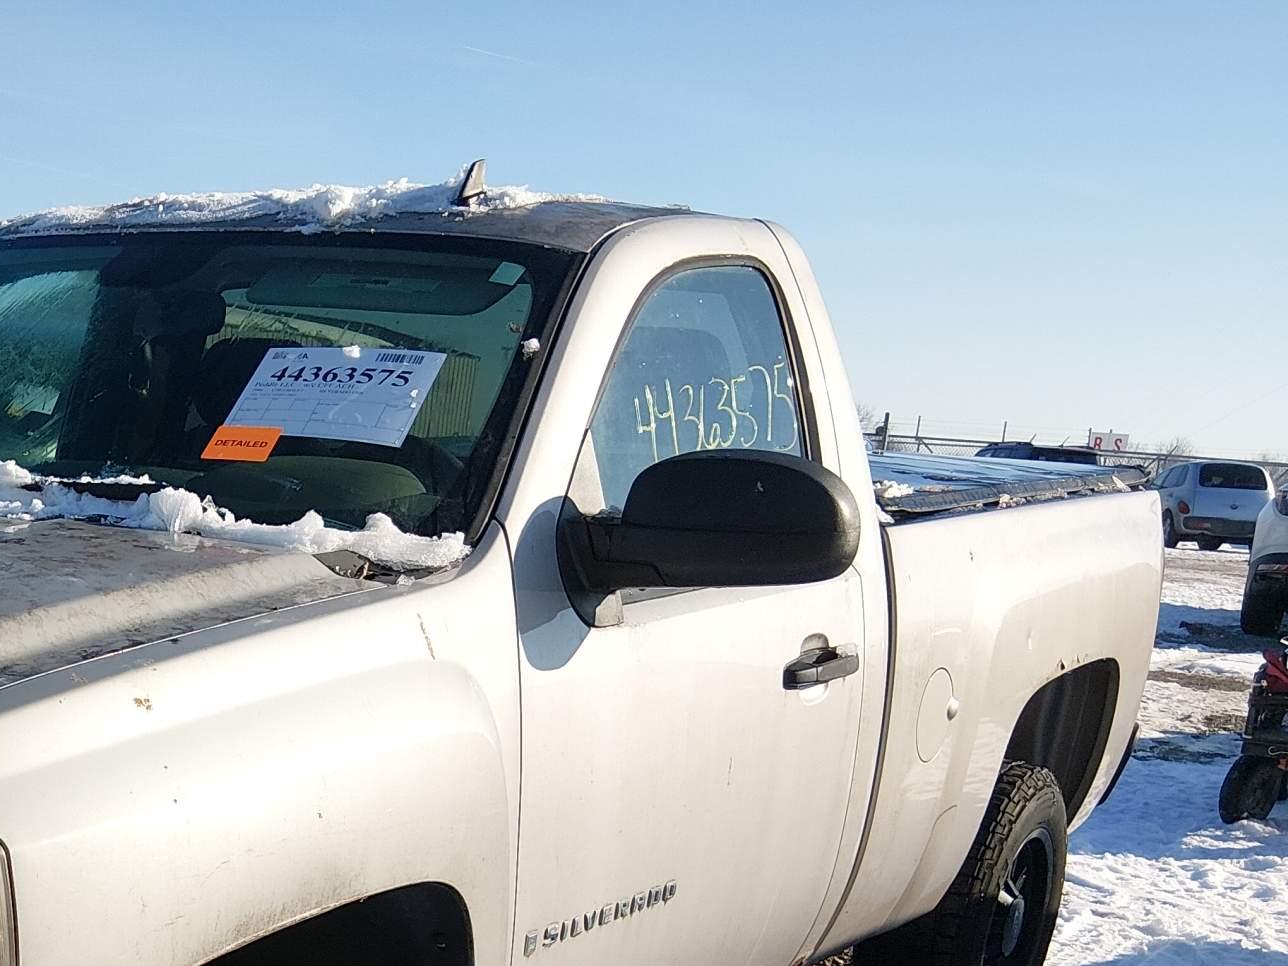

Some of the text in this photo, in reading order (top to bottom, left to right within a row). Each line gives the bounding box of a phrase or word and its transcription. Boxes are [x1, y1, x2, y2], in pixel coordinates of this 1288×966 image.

[270, 366, 414, 387] 44363575
[634, 362, 798, 463] 44363575
[214, 439, 268, 448] DETAILED
[542, 879, 677, 947] SILVERADO
